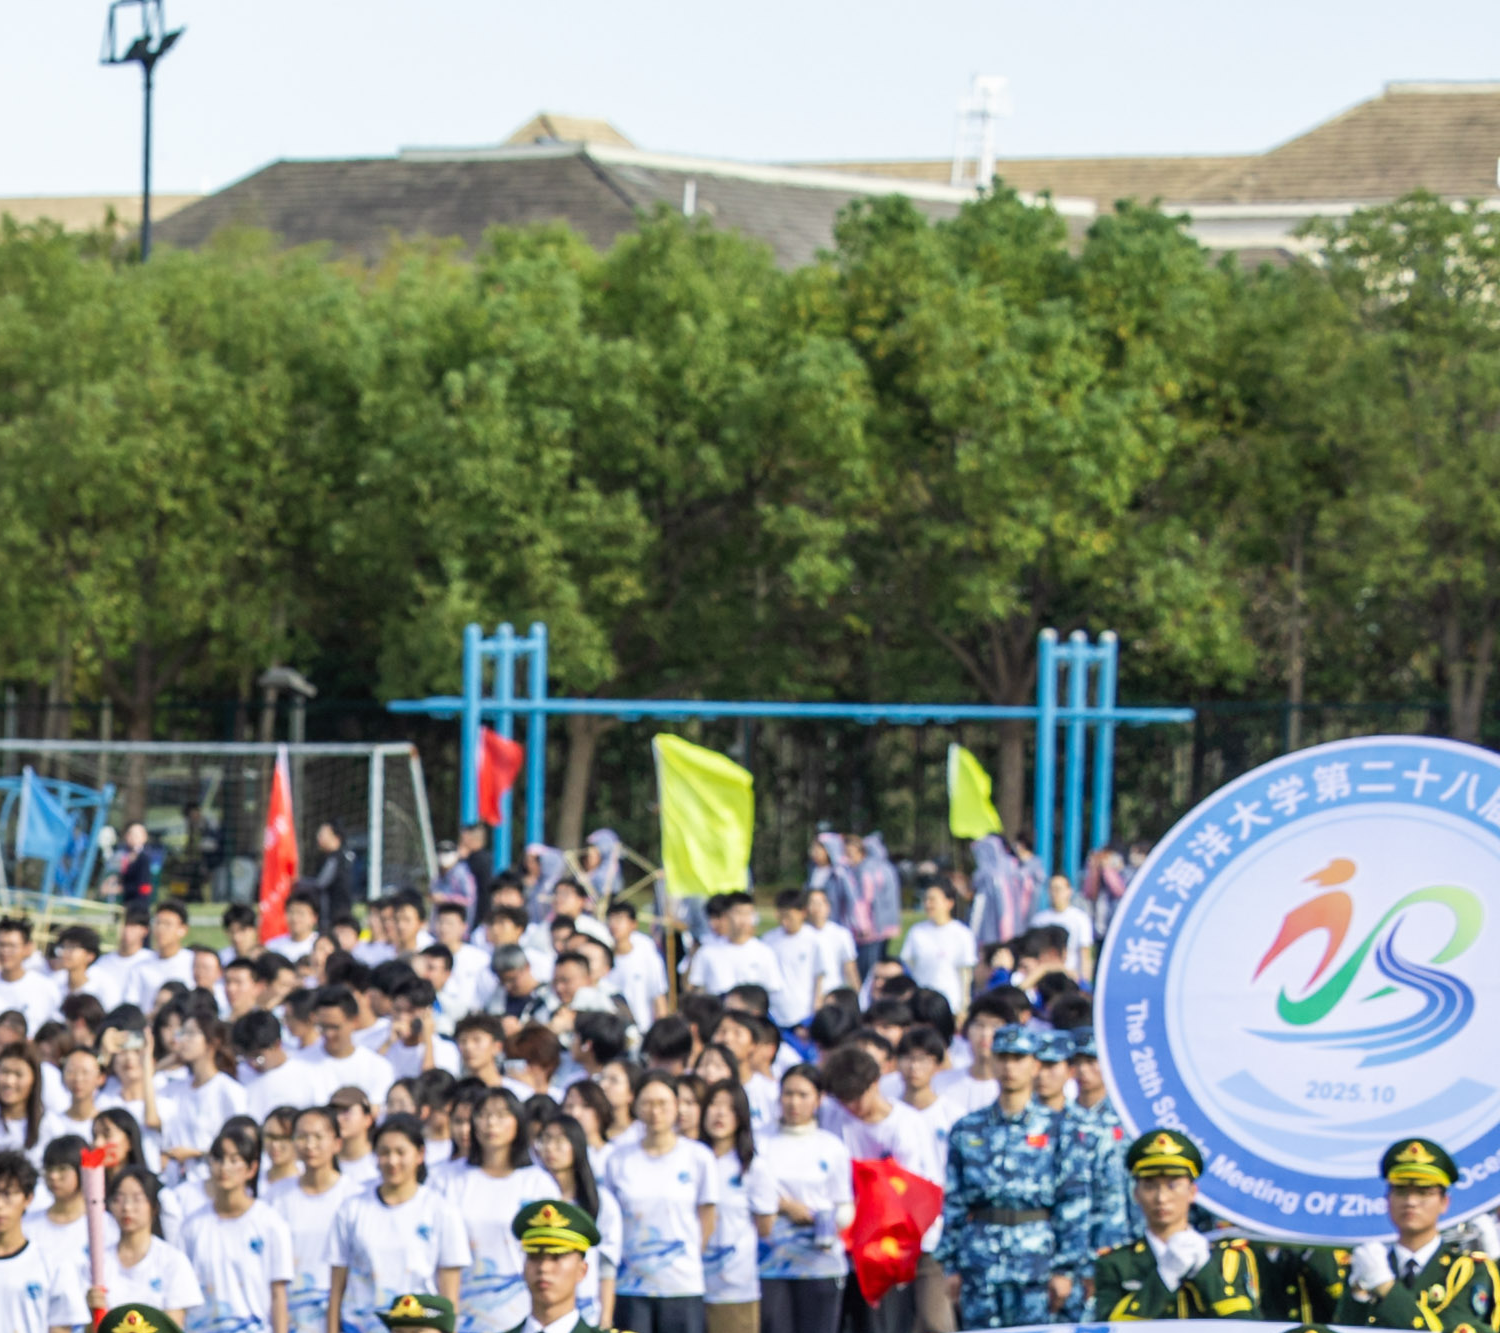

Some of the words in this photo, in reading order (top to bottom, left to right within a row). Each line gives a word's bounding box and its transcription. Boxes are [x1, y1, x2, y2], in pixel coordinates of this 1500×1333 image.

[1305, 1080, 1396, 1106] 2025.10
[1207, 1153, 1301, 1215] Meeting
[1304, 1190, 1338, 1217] Of
